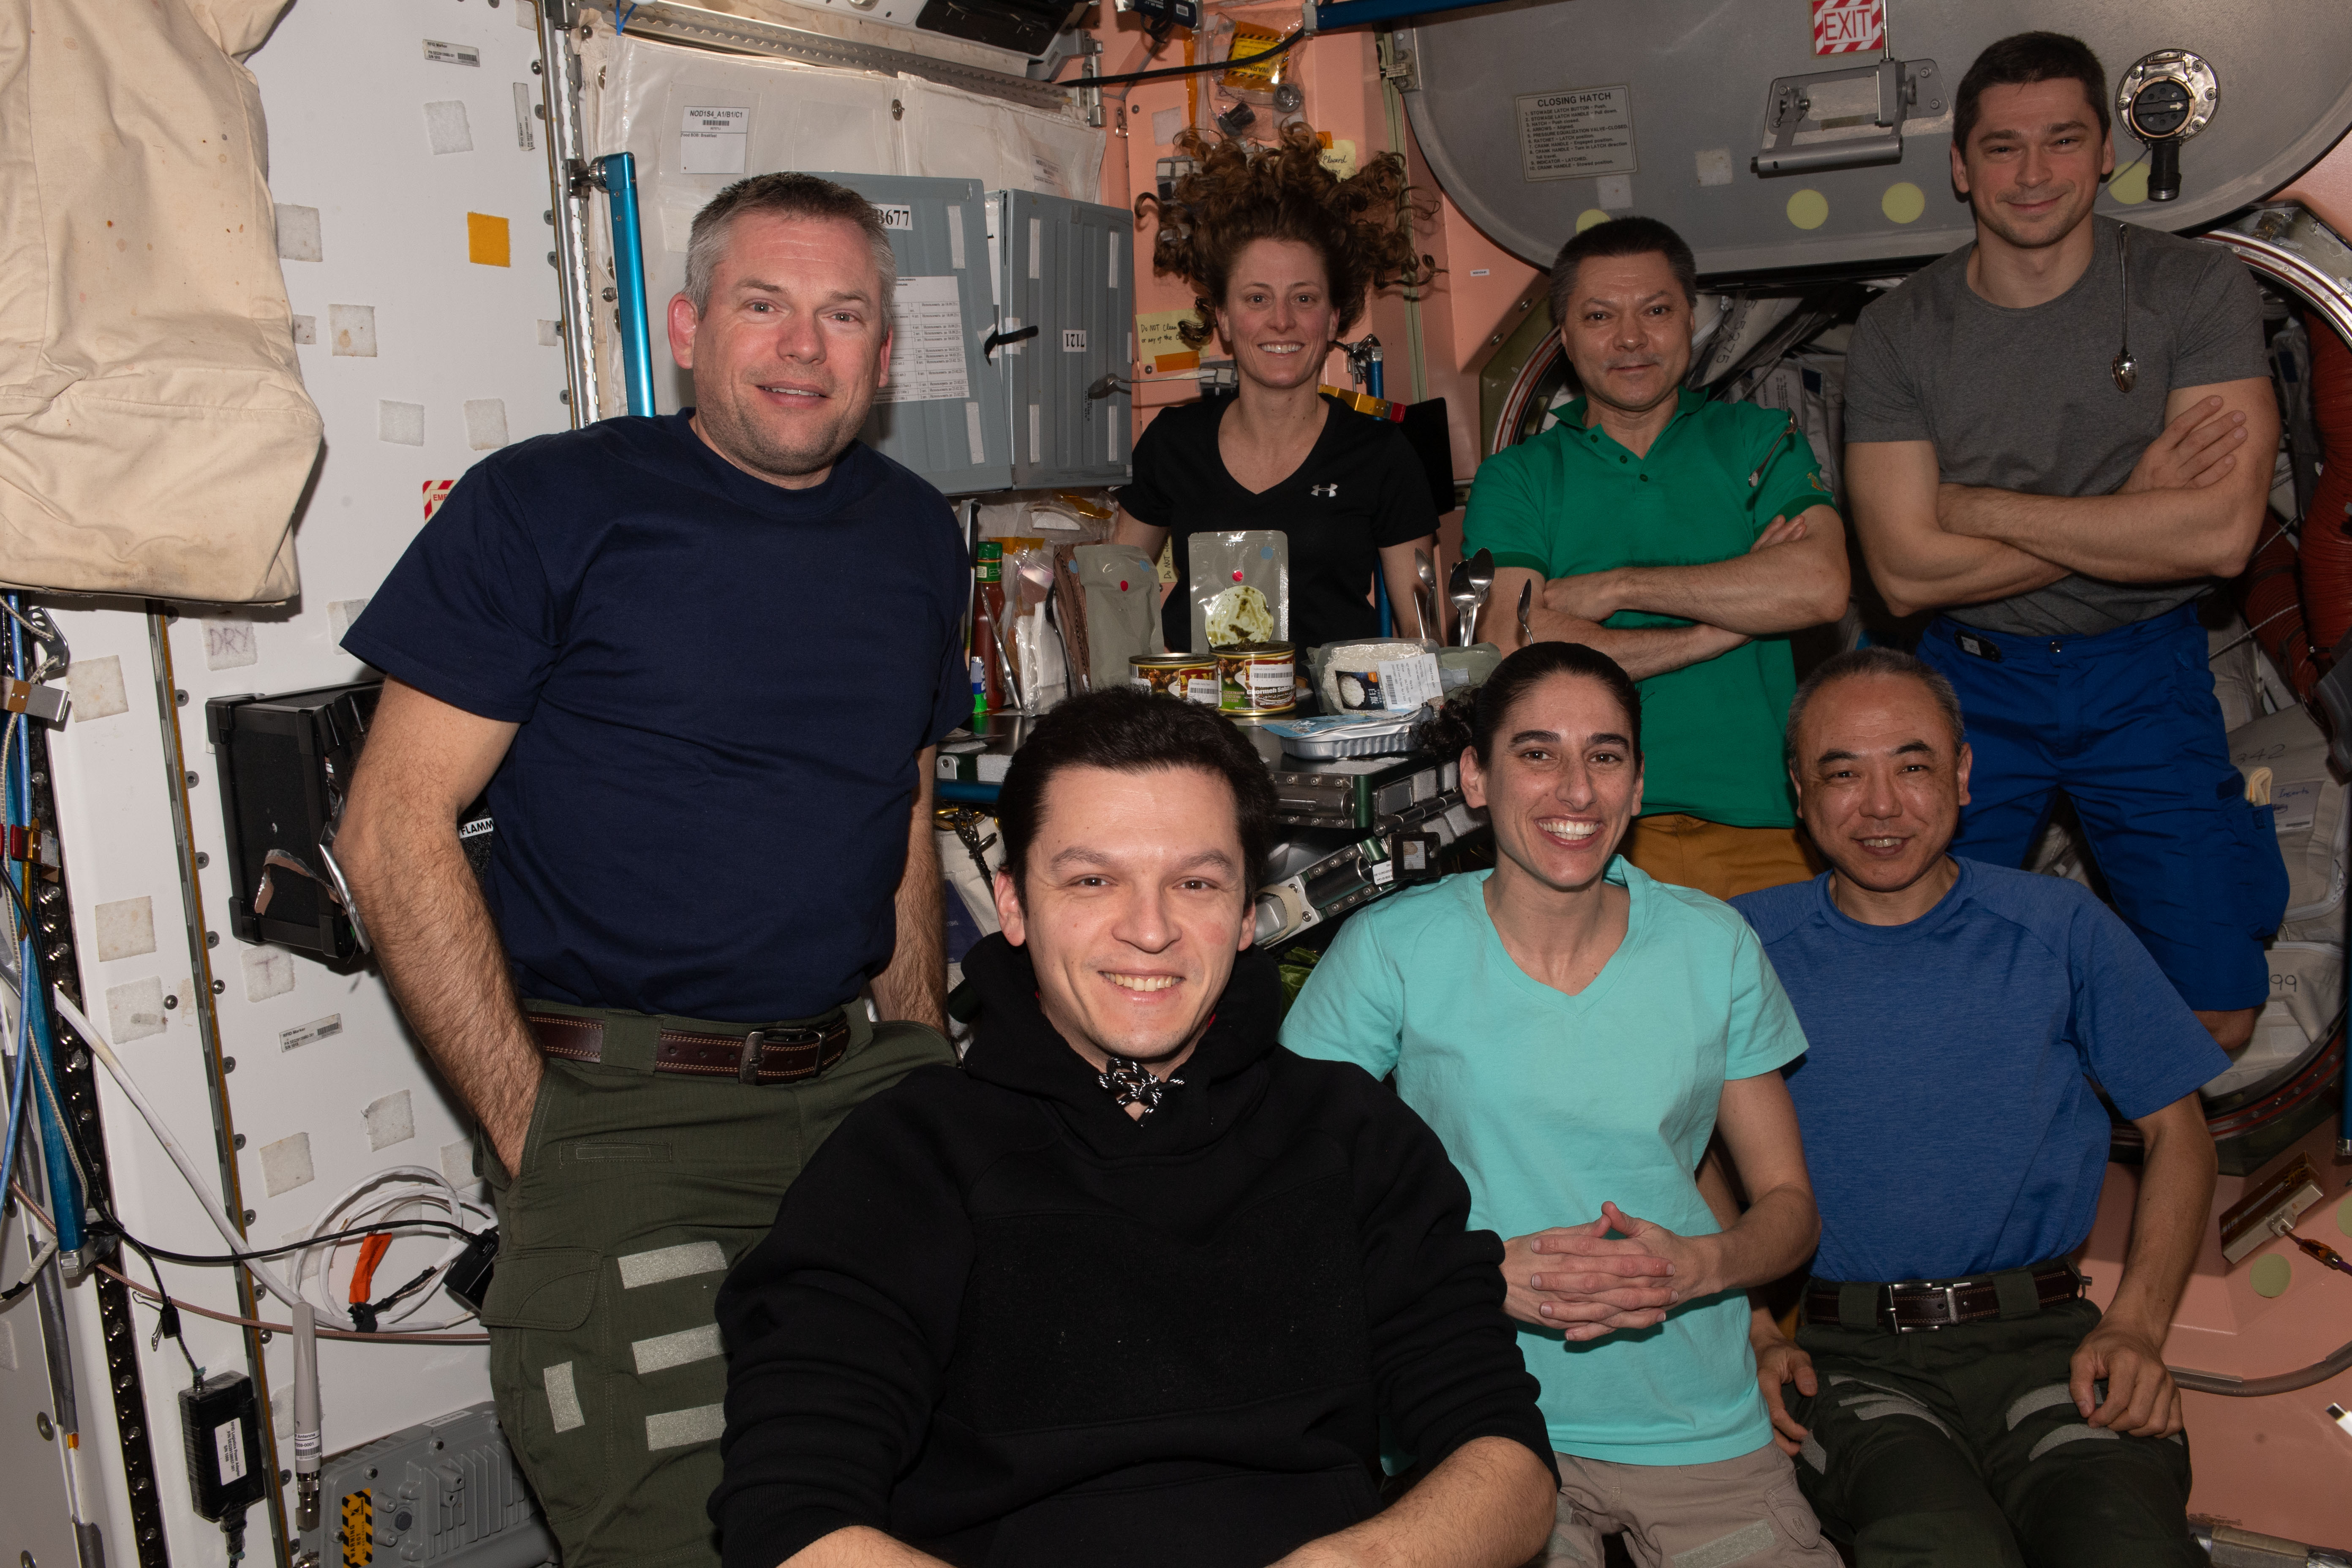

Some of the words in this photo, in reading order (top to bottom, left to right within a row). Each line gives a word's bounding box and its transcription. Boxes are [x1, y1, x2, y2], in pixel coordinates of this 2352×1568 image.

[1824, 9, 1870, 41] EXIT
[1538, 95, 1576, 107] CLOSING
[1579, 92, 1611, 103] HATCH
[1323, 155, 1347, 163] Placard
[1141, 324, 1147, 333] Do
[1066, 333, 1085, 348] 7121
[210, 626, 249, 656] DRY
[1368, 689, 1379, 704] 白飯
